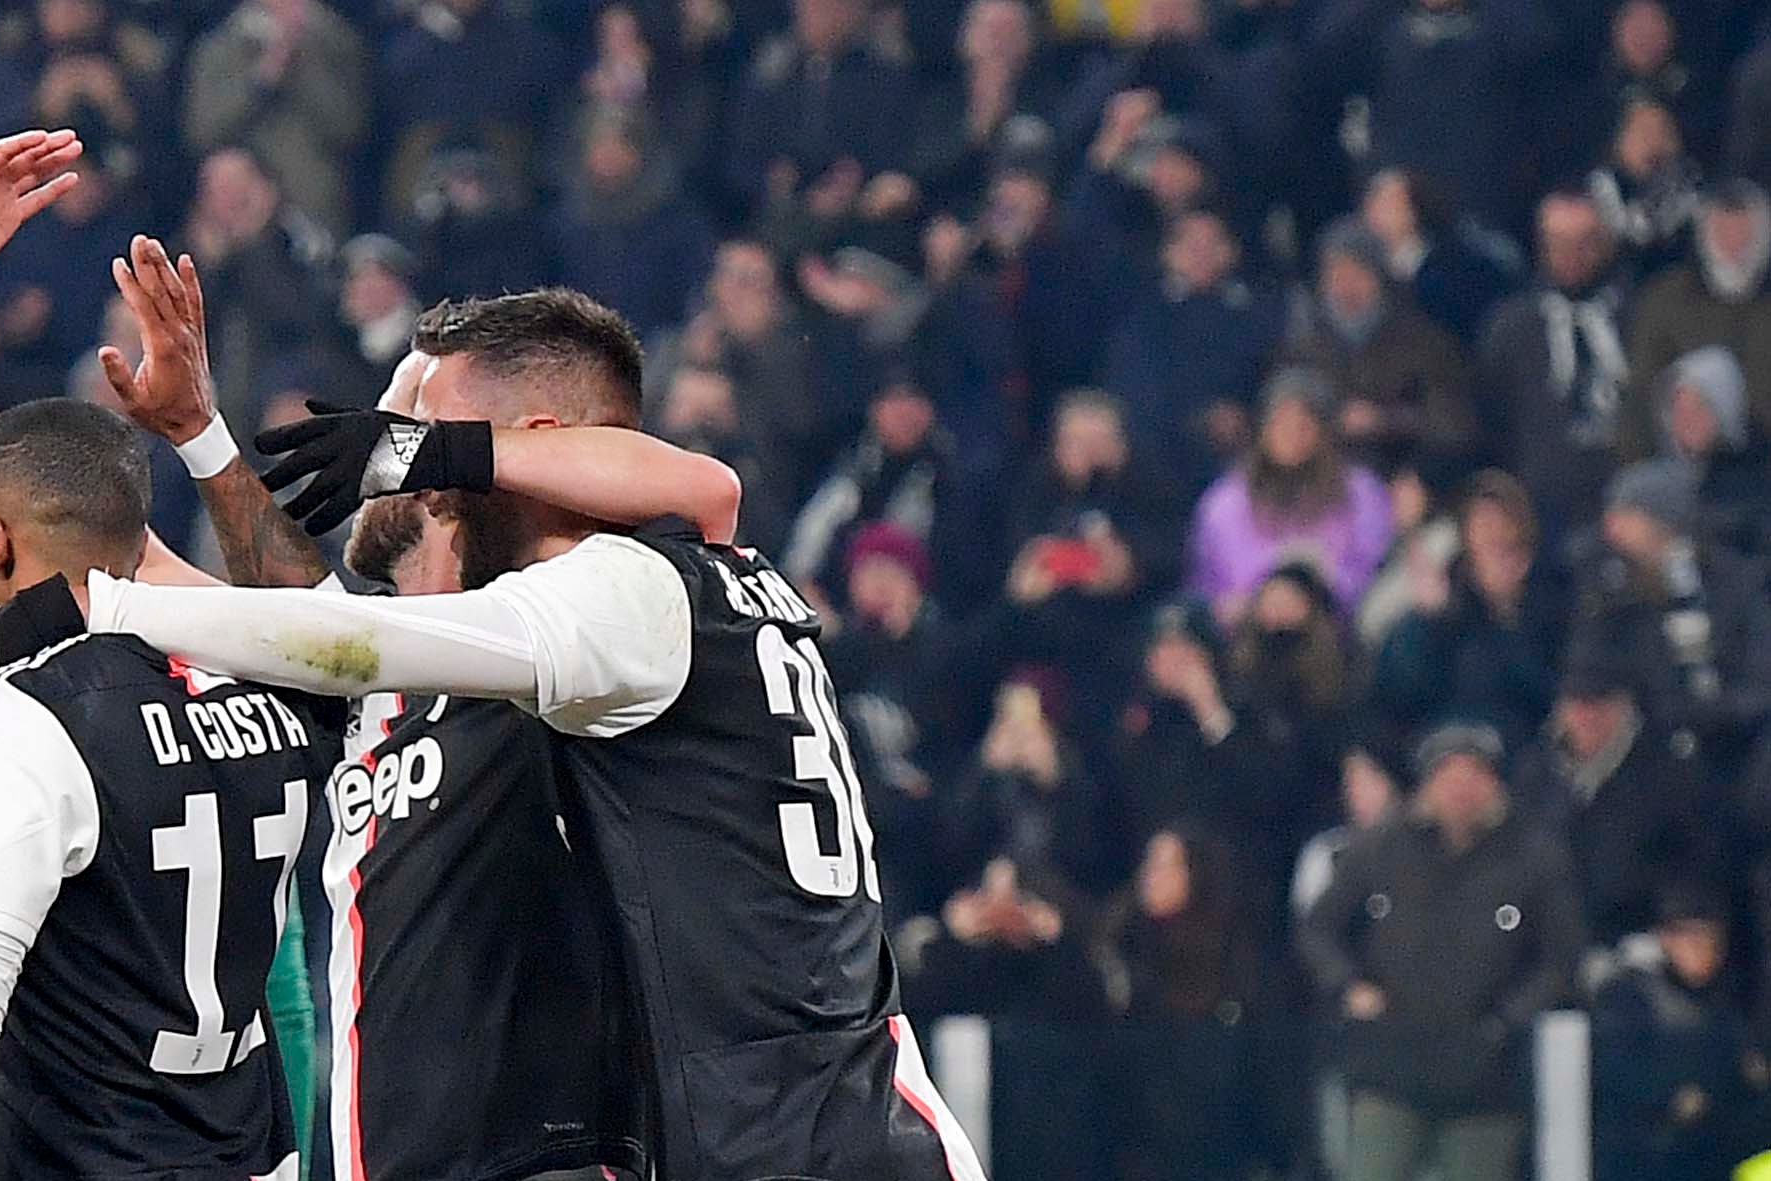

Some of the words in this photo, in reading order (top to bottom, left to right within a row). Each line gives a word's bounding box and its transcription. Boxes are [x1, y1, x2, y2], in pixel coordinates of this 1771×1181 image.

[140, 702, 192, 766] D.
[184, 692, 309, 760] COSTA
[327, 736, 443, 837] eep
